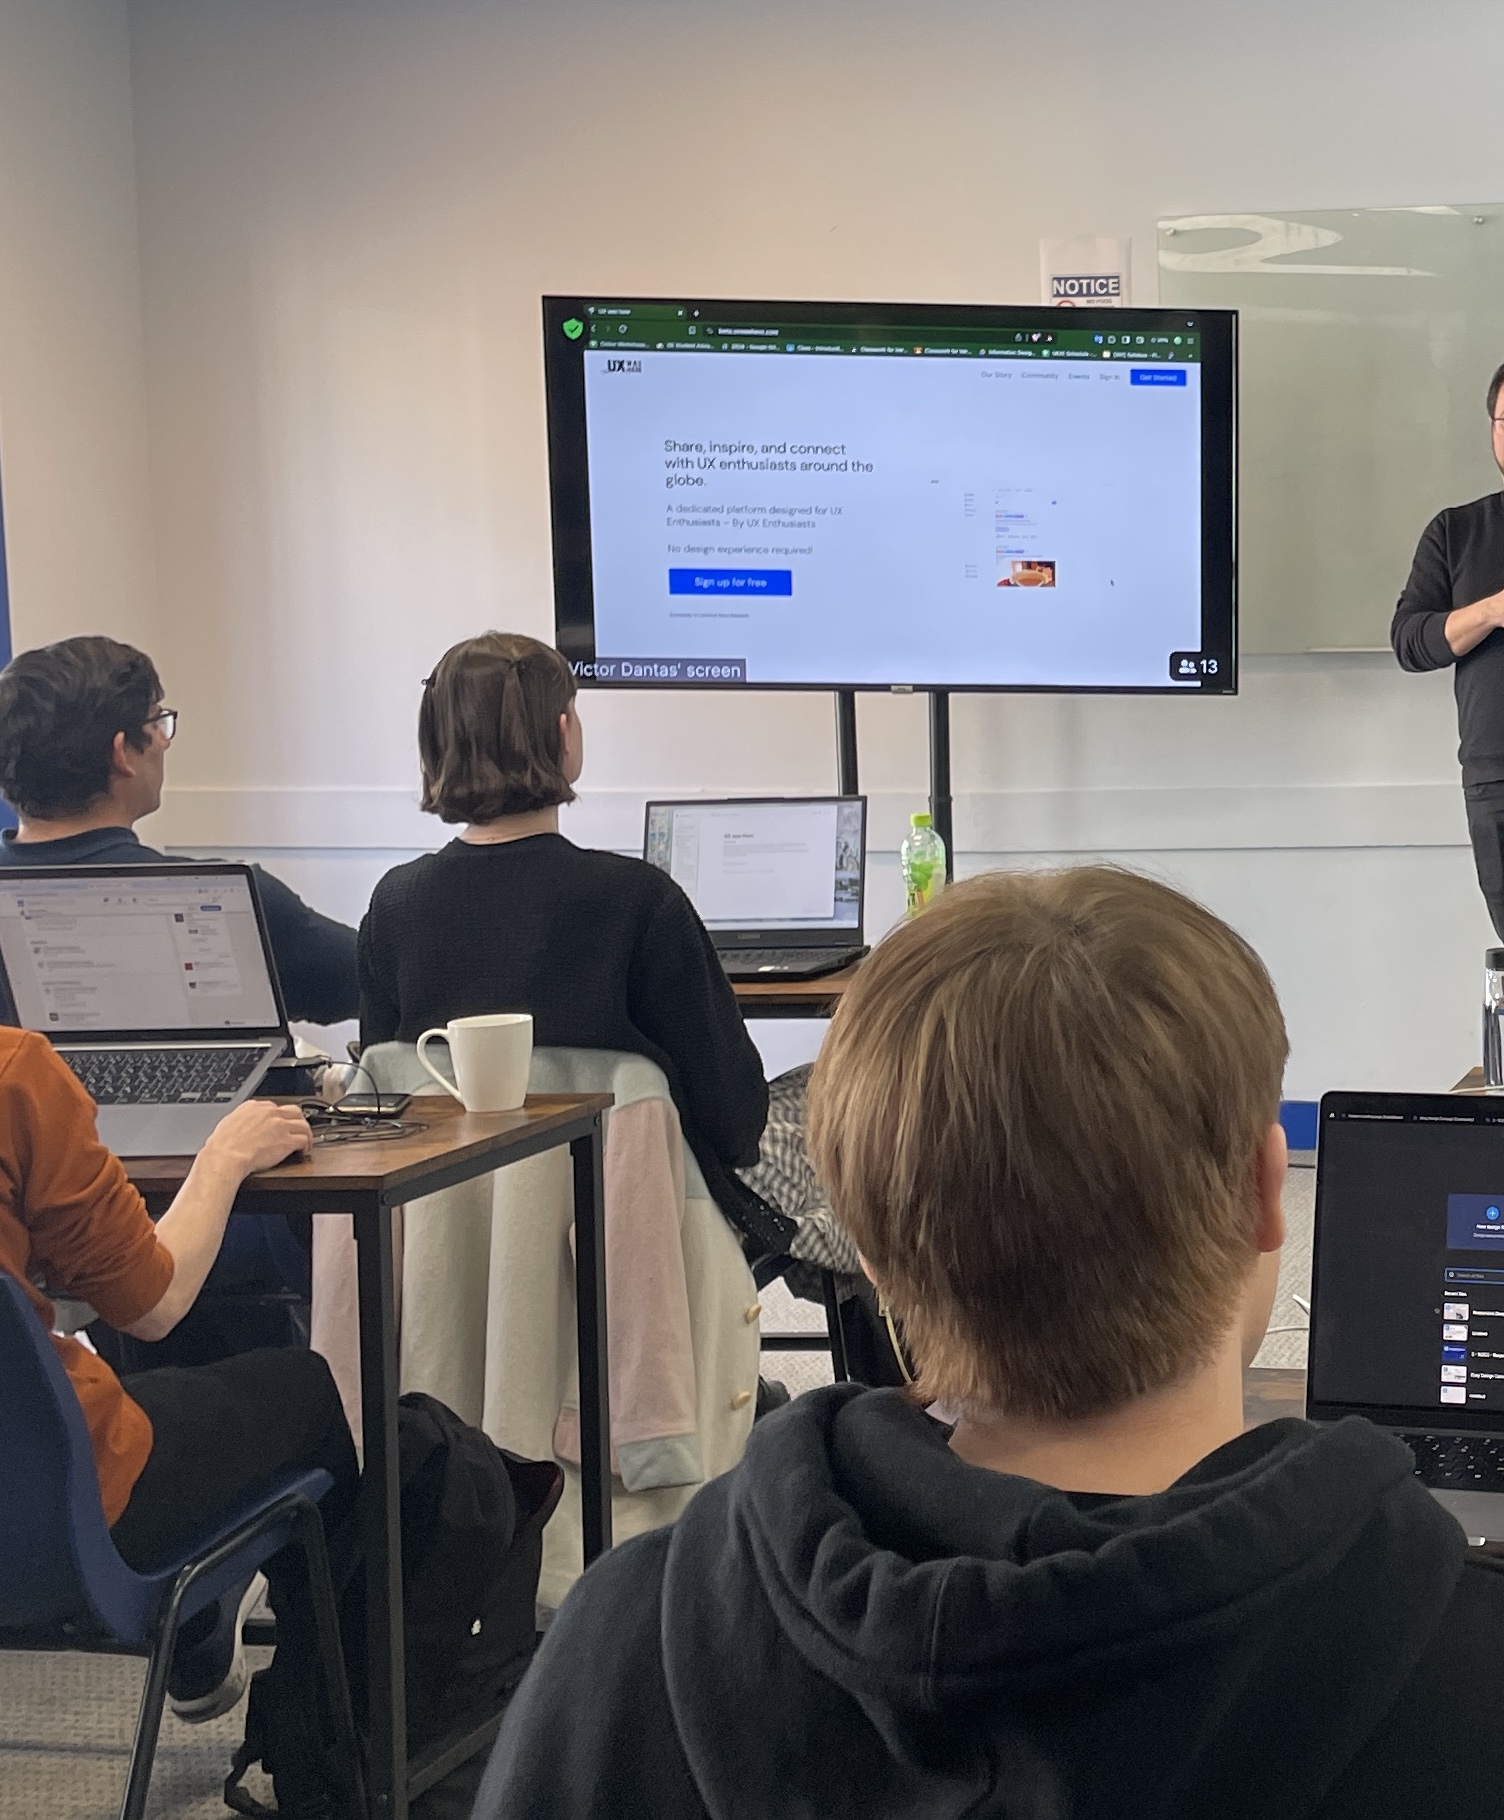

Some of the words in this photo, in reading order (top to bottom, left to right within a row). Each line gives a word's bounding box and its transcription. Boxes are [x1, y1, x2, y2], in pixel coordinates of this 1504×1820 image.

[1053, 278, 1120, 295] NOTICE
[664, 440, 707, 454] Share,
[709, 441, 757, 455] inspire,
[760, 442, 787, 454] and
[789, 444, 846, 455] connect
[665, 457, 695, 469] with
[697, 457, 716, 470] UX
[719, 458, 797, 471] enthusiasts
[800, 460, 848, 473] around
[851, 460, 874, 473] the
[665, 473, 707, 489] globe.
[666, 504, 673, 513] A
[675, 504, 725, 514] dedicated
[726, 505, 767, 516] platform
[769, 505, 813, 516] designed
[814, 505, 828, 515] for
[829, 506, 843, 515] UX
[666, 517, 721, 527] Enthusiasts
[732, 518, 745, 528] By
[746, 518, 760, 528] UX
[762, 518, 816, 528] Enthusiasts
[667, 544, 681, 553] No
[683, 544, 715, 556] design
[717, 545, 769, 556] experience
[694, 577, 715, 589] Sign
[716, 579, 730, 589] up
[732, 577, 746, 587] for
[747, 577, 768, 588] free
[568, 661, 616, 677] Victor
[621, 662, 681, 677] Dantas'
[686, 664, 741, 678] screen
[1200, 659, 1218, 674] 13
